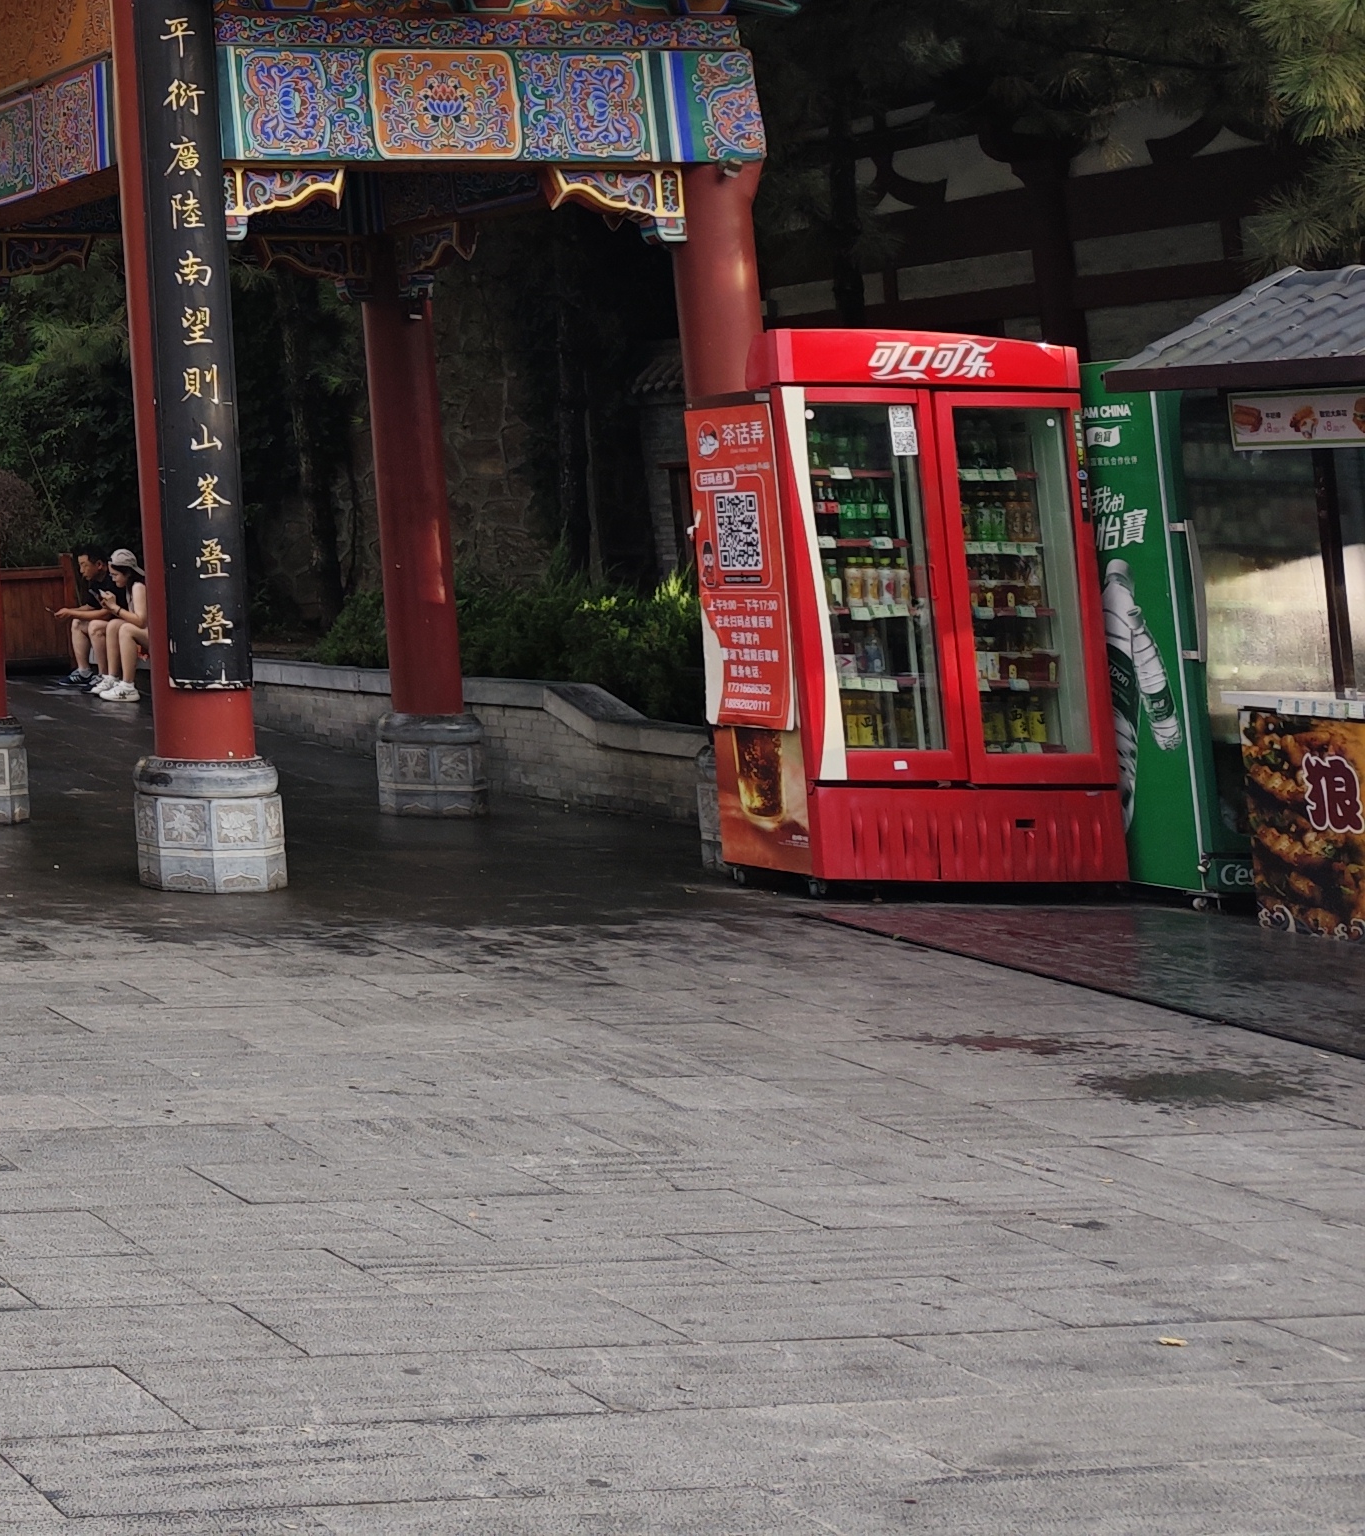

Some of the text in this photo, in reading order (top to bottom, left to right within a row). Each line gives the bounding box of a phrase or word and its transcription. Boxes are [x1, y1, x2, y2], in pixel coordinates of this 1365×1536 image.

[868, 340, 997, 380] 可口可乐
[1100, 404, 1131, 418] CHINA
[721, 421, 765, 446] 茶话弄
[1091, 485, 1125, 516] 我的
